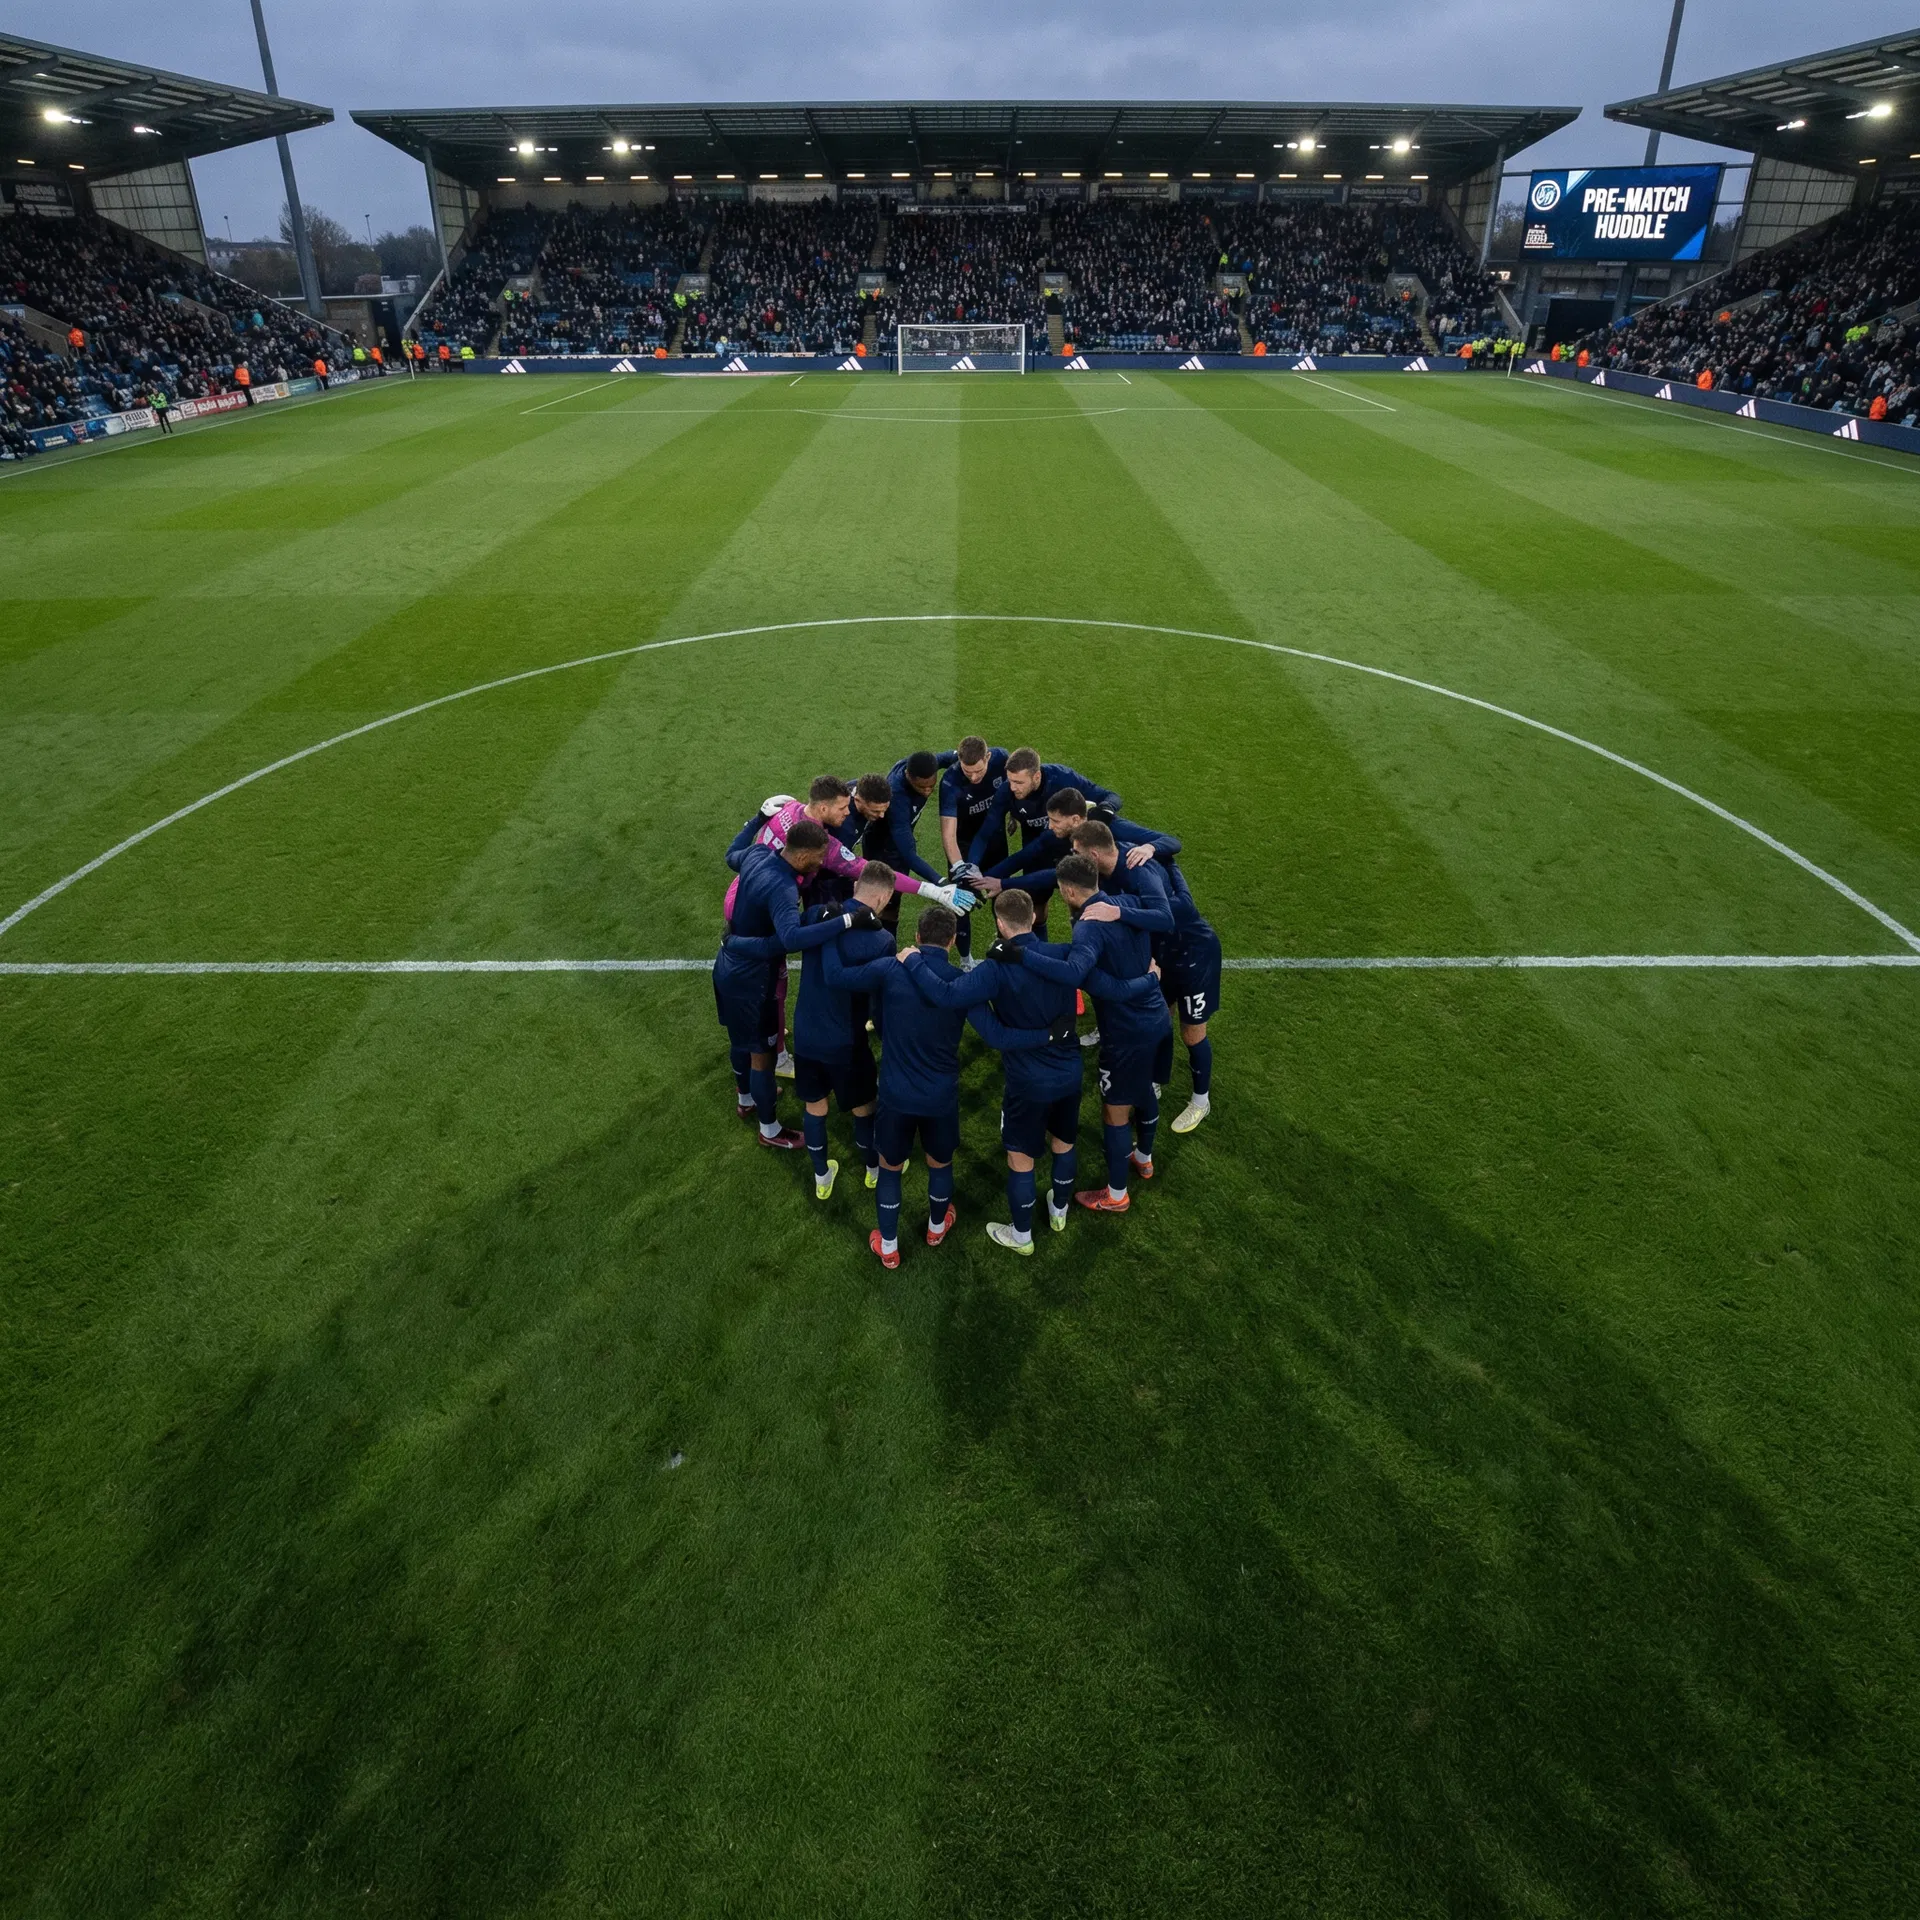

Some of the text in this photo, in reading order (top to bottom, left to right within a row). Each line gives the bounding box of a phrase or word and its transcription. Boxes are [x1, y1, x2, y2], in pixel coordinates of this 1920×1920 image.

[1582, 186, 1691, 213] PRE-MATCH
[1594, 213, 1669, 239] HUDDLE
[1184, 992, 1207, 1018] 13
